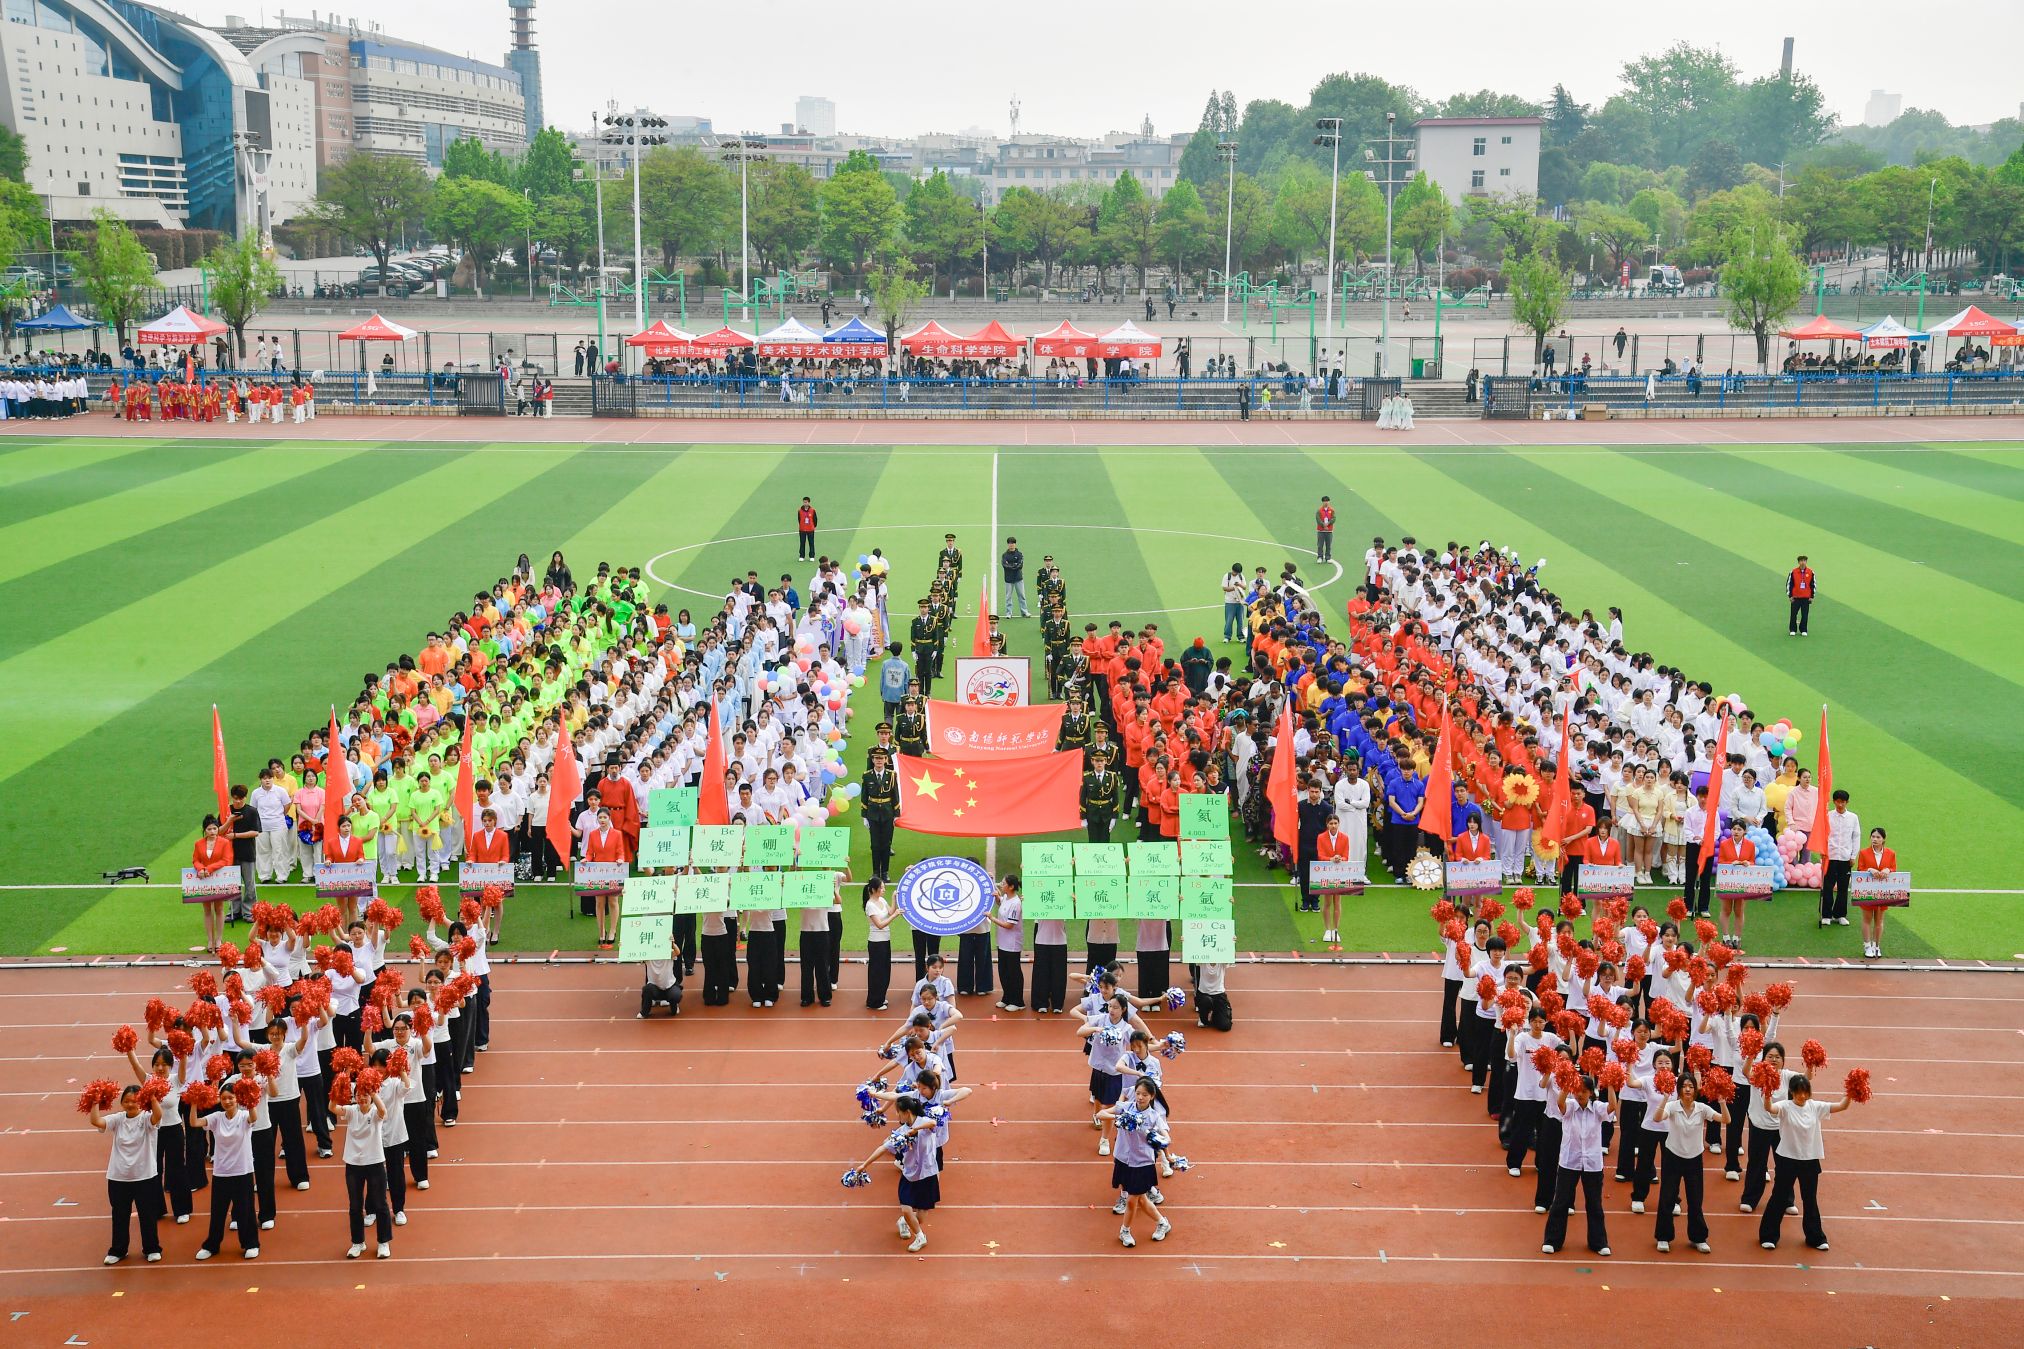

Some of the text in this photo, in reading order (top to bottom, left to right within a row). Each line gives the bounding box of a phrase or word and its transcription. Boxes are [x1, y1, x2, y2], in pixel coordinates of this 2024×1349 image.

[655, 345, 728, 357] 化学与制药工程学院
[762, 345, 886, 356] 美术与艺术设计学院
[921, 345, 1007, 355] 生命科学学院
[1040, 344, 1153, 356] 体育学院
[974, 681, 994, 697] 45
[969, 729, 1049, 745] 南阳师范学院
[666, 801, 681, 813] 氢
[1197, 809, 1211, 822] 氦
[657, 841, 672, 852] 锂
[710, 840, 725, 851] 铍
[762, 839, 777, 850] 硼
[817, 840, 831, 852] 碳
[1041, 853, 1054, 864] 氮
[1093, 853, 1107, 863] 氧
[1147, 853, 1161, 863] 氟
[1200, 852, 1214, 862] 氖
[704, 876, 720, 884] Mg
[695, 887, 709, 899] 镁
[749, 884, 763, 895] 铝
[802, 883, 816, 894] 硅
[641, 889, 656, 901] 钠
[1040, 890, 1056, 903] 磷
[1094, 890, 1109, 903] 硫
[1146, 890, 1161, 903] 氯
[1199, 892, 1214, 905] 氩
[640, 932, 654, 944] 钾
[1201, 933, 1217, 948] 钙
